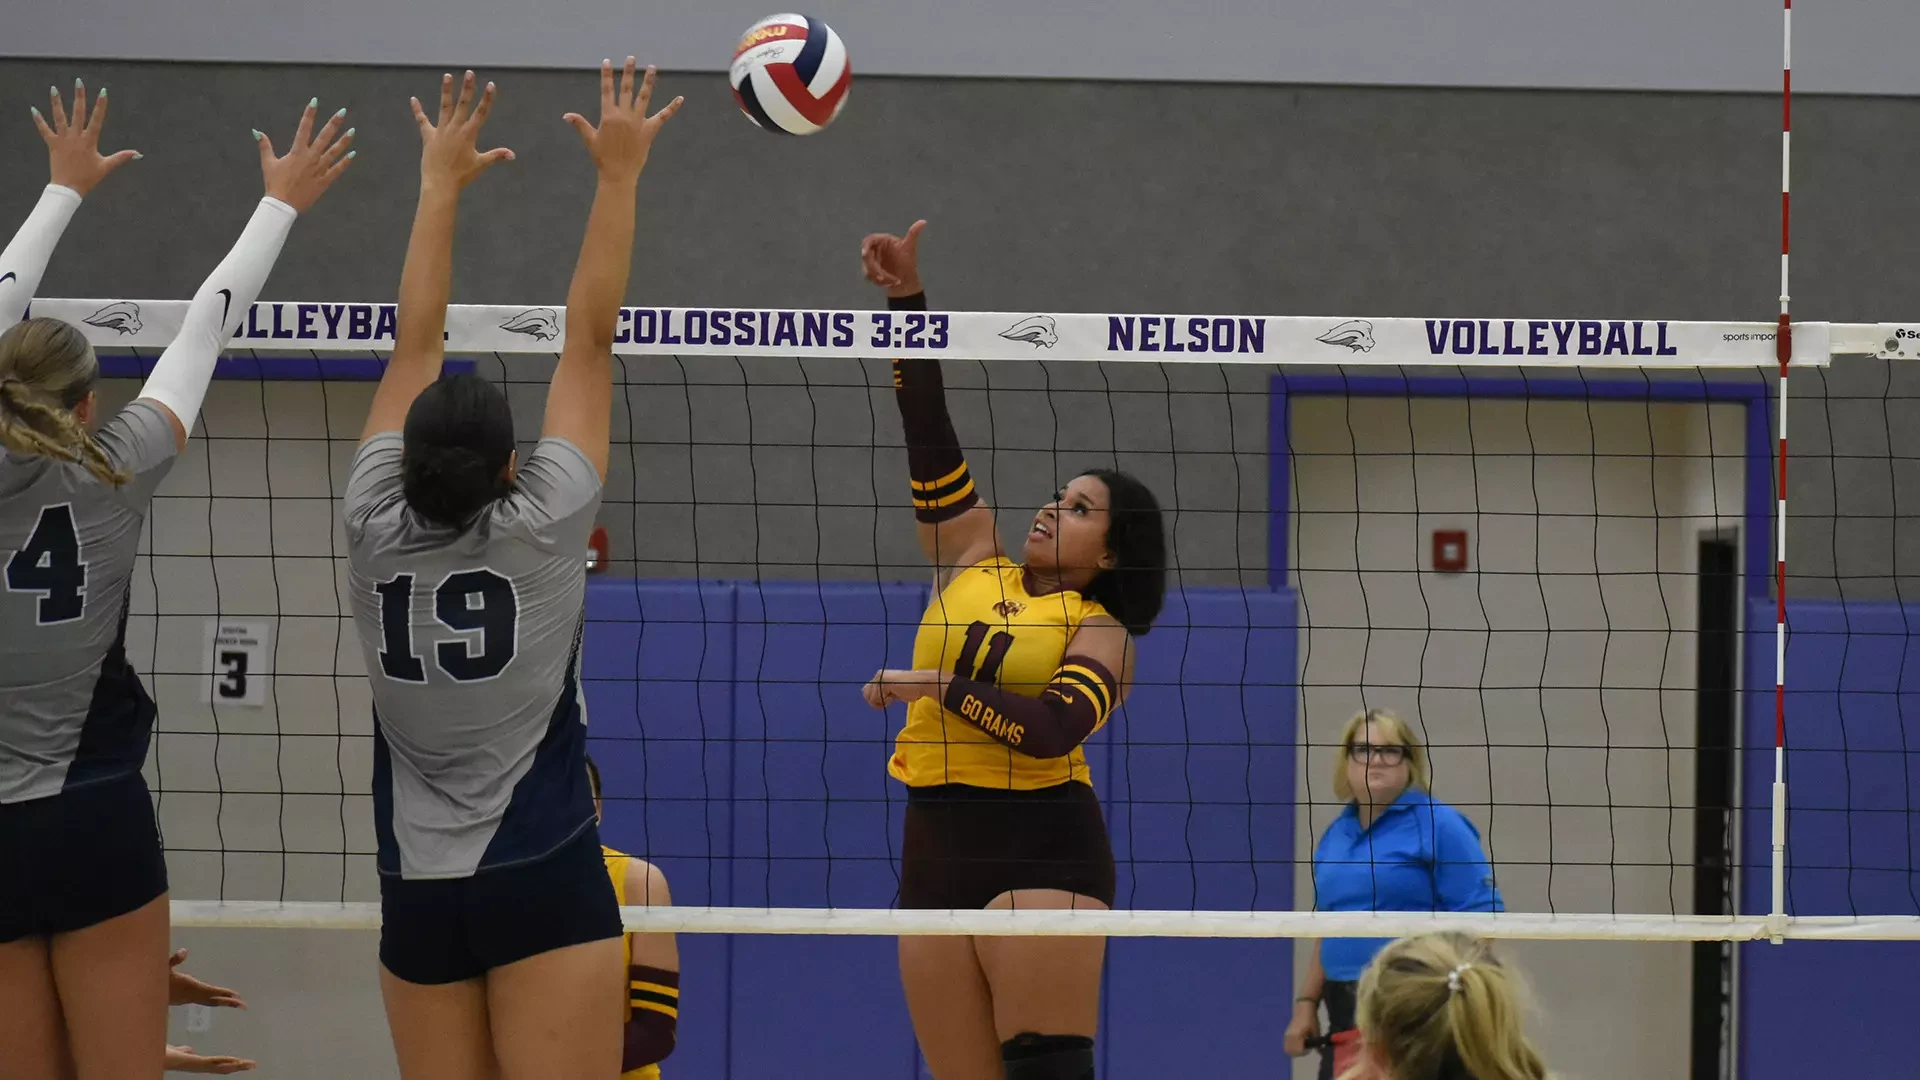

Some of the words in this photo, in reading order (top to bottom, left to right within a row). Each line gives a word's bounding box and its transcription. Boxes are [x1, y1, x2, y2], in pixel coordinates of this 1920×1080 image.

[613, 309, 854, 347] COLOSSIANS
[870, 313, 949, 348] 3:23
[1107, 316, 1266, 353] NELSON
[1425, 320, 1677, 356] VOLLEYBALL
[1723, 333, 1750, 342] sports
[1750, 333, 1777, 342] impor
[4, 502, 88, 626] 4
[372, 566, 520, 684] 19
[219, 651, 248, 698] 3
[953, 620, 1015, 685] 11
[960, 694, 983, 721] GO
[980, 706, 1025, 746] RAMS
